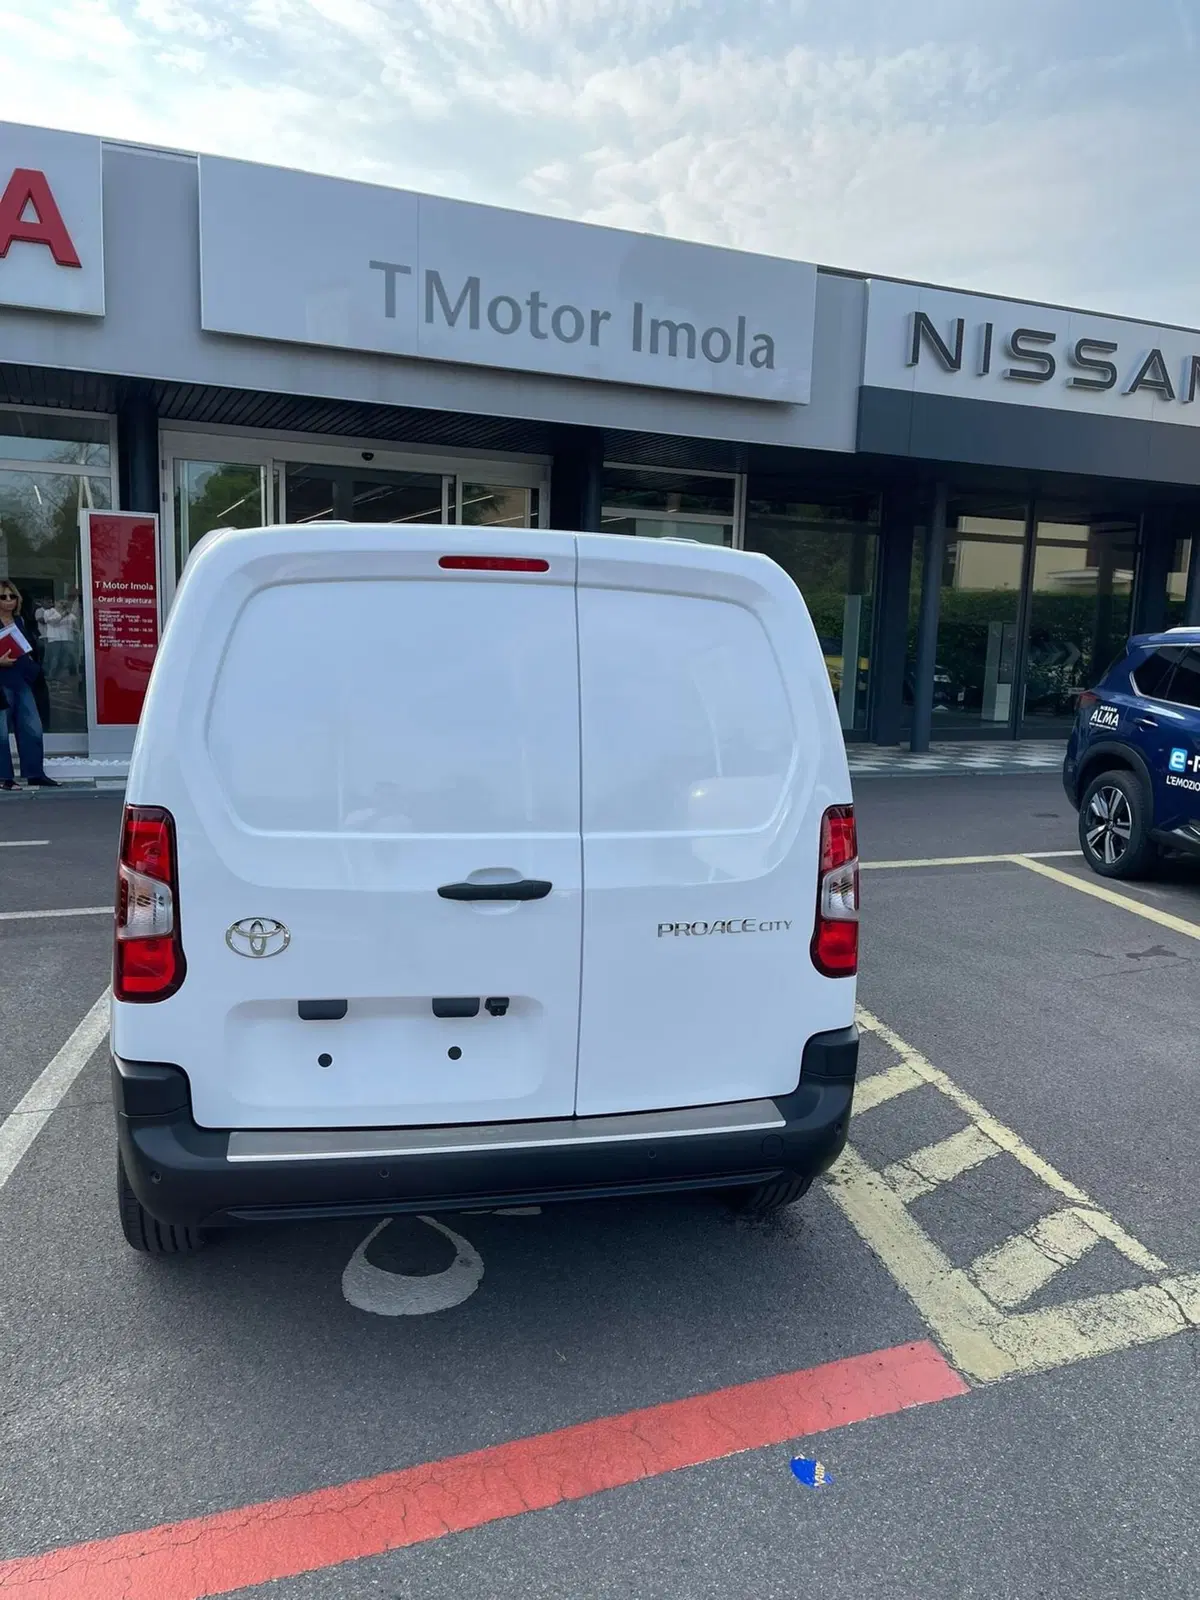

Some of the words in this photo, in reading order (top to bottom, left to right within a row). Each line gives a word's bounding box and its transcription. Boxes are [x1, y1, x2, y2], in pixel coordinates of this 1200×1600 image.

[369, 260, 411, 318] T
[424, 269, 612, 346] Motor
[632, 302, 775, 369] Imola
[95, 580, 101, 589] T
[103, 581, 129, 589] Motor
[130, 582, 154, 590] Imola
[98, 595, 116, 603] Orari
[1090, 709, 1119, 726] ALMA
[657, 918, 757, 938] PROACE
[758, 919, 793, 932] CITY
